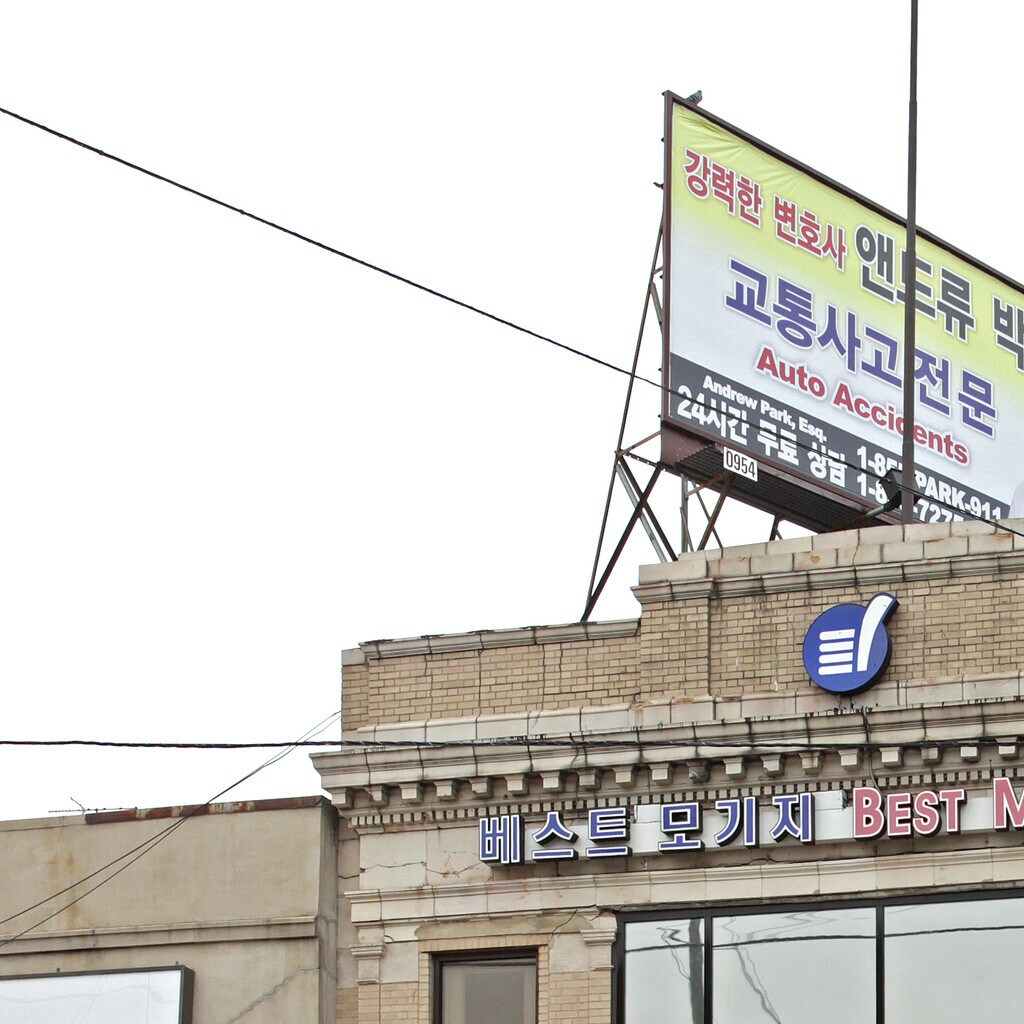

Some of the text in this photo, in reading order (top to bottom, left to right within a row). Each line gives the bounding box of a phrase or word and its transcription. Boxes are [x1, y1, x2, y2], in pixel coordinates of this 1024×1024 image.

[684, 148, 762, 228] 강력한
[774, 195, 847, 272] 변호사
[855, 225, 976, 342] 앤드류
[757, 347, 826, 398] Auto
[677, 385, 848, 488] 24시간 무료 상담
[703, 375, 827, 442] Andrew Park, Esq.
[726, 450, 756, 477] 0954
[479, 792, 814, 863] 베스트 모기지
[853, 787, 965, 838] BEST
